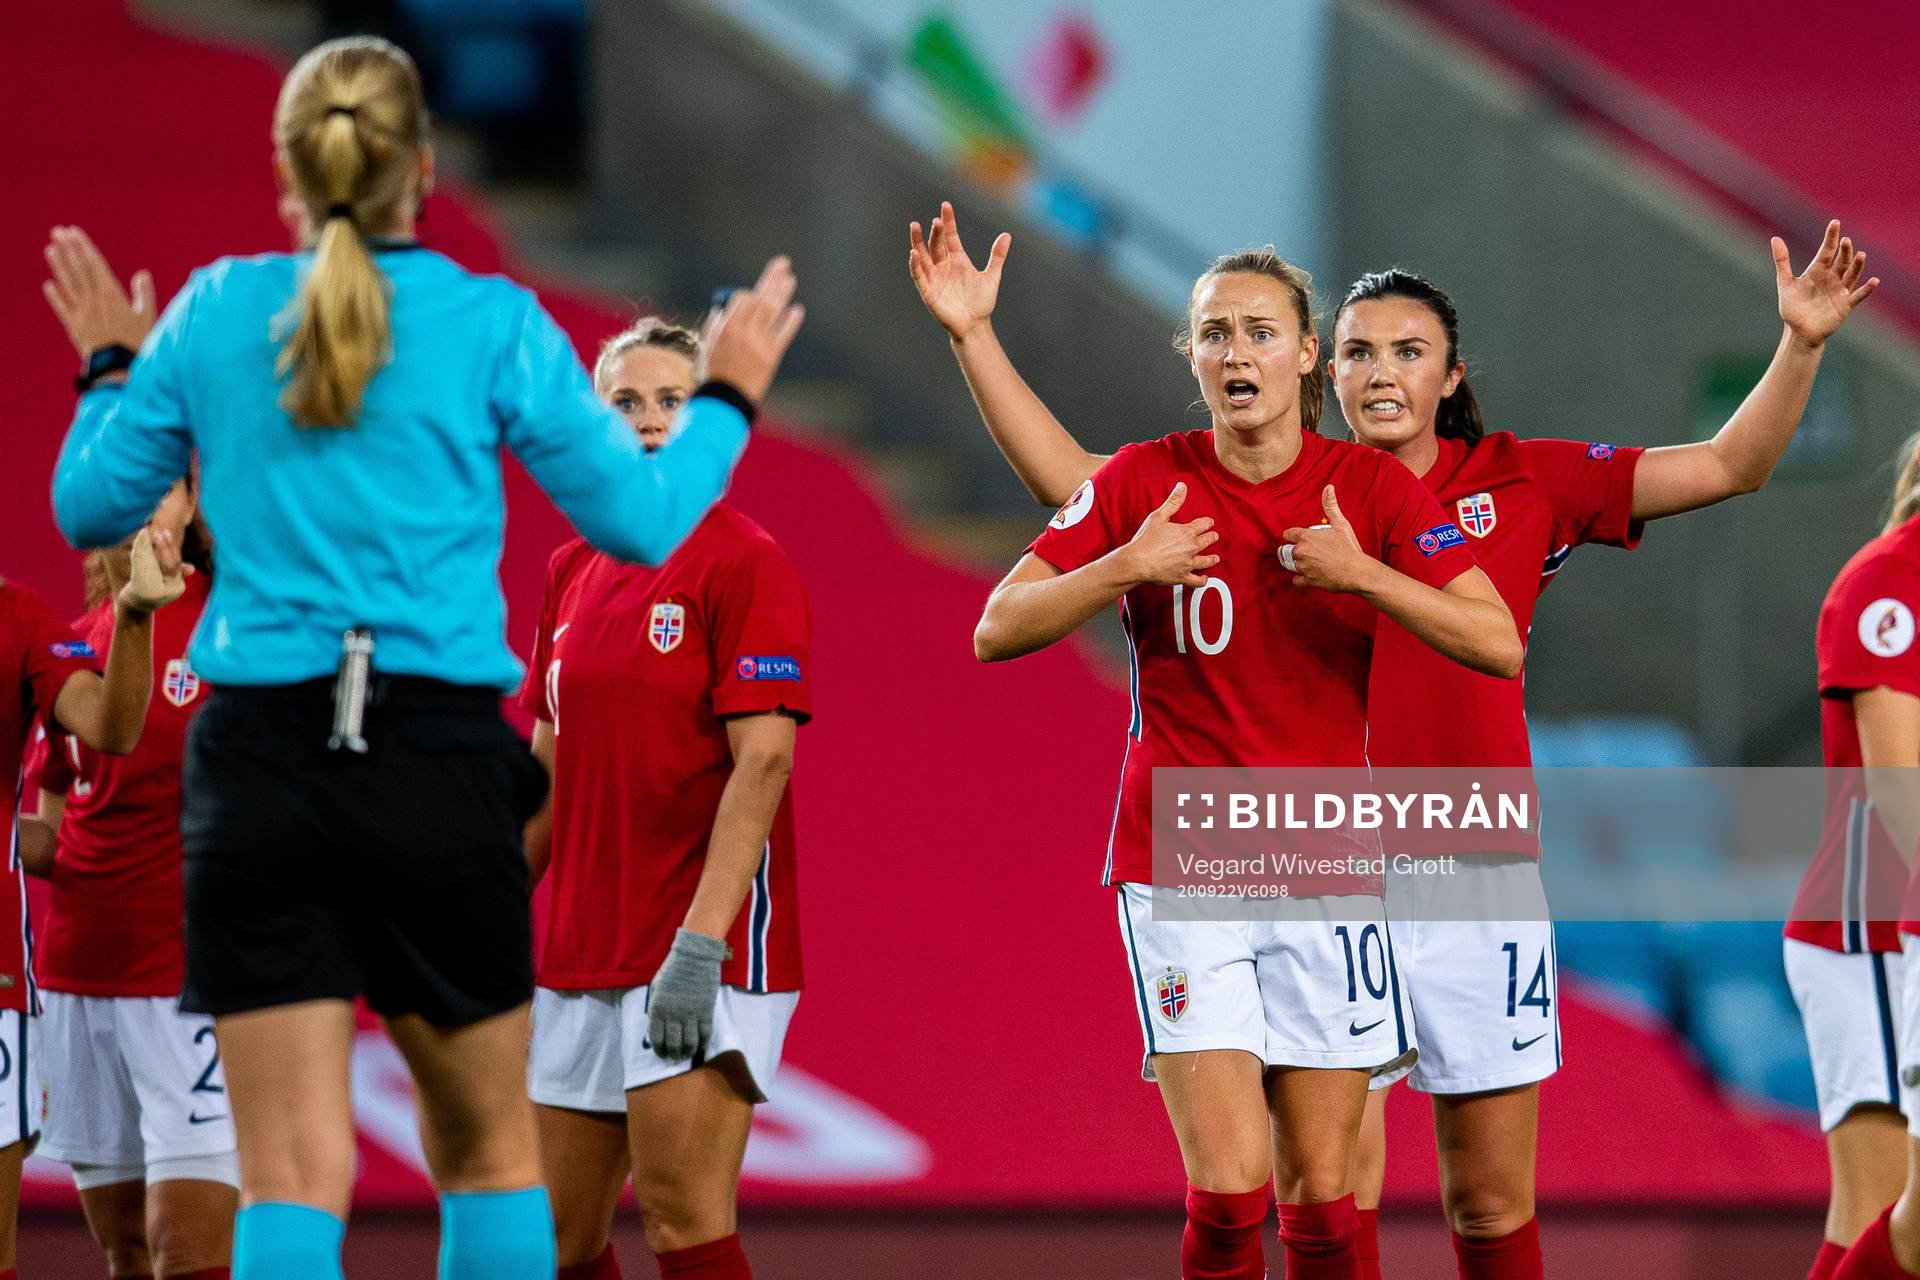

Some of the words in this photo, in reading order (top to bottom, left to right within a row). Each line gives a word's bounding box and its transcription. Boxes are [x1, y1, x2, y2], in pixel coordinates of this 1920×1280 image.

[1173, 577, 1233, 655] 10
[1335, 924, 1387, 1002] 10
[1502, 942, 1551, 1018] 14
[192, 1027, 224, 1092] 2
